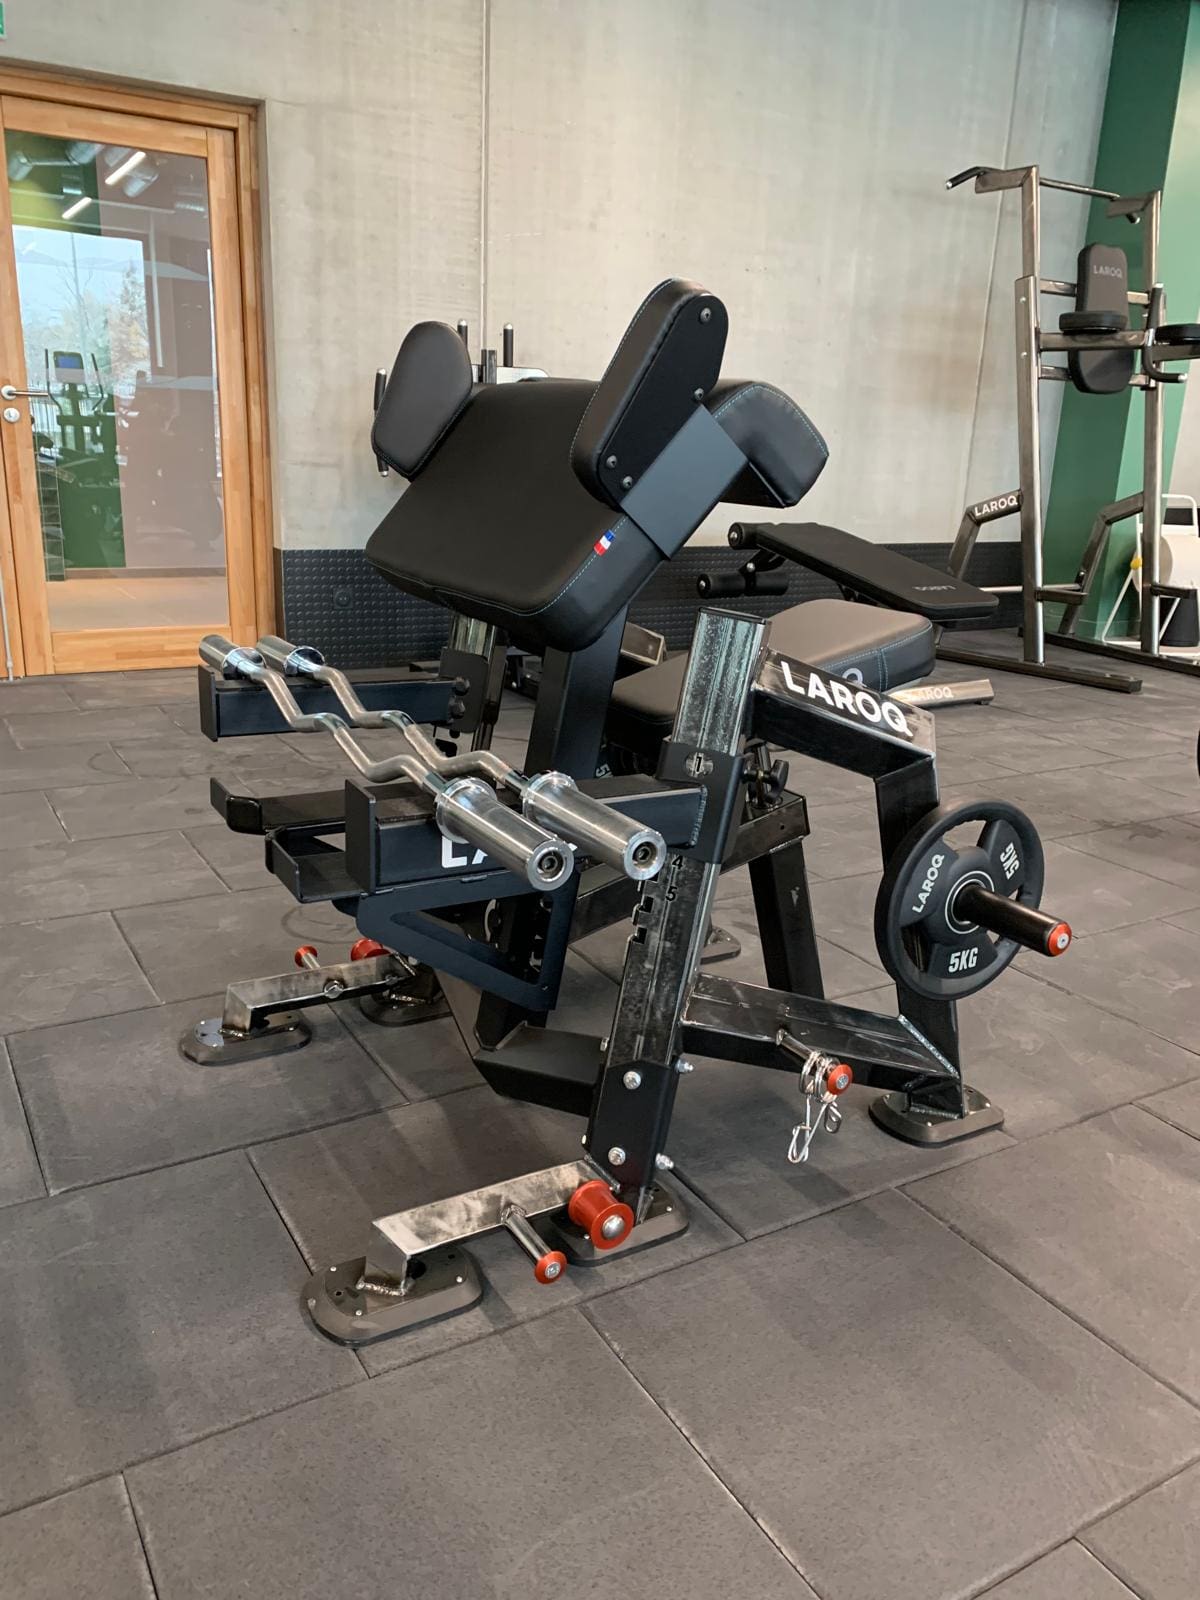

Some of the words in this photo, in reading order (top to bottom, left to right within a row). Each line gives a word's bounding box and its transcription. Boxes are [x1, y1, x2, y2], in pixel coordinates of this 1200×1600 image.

[1093, 265, 1122, 278] LAROQ
[974, 495, 1018, 516] LAROQ
[780, 661, 914, 737] LAROQ
[672, 855, 683, 870] 4
[1000, 842, 1020, 880] 5KG
[665, 886, 677, 901] 5
[912, 854, 945, 913] LAROQ
[948, 947, 979, 973] 5KG
